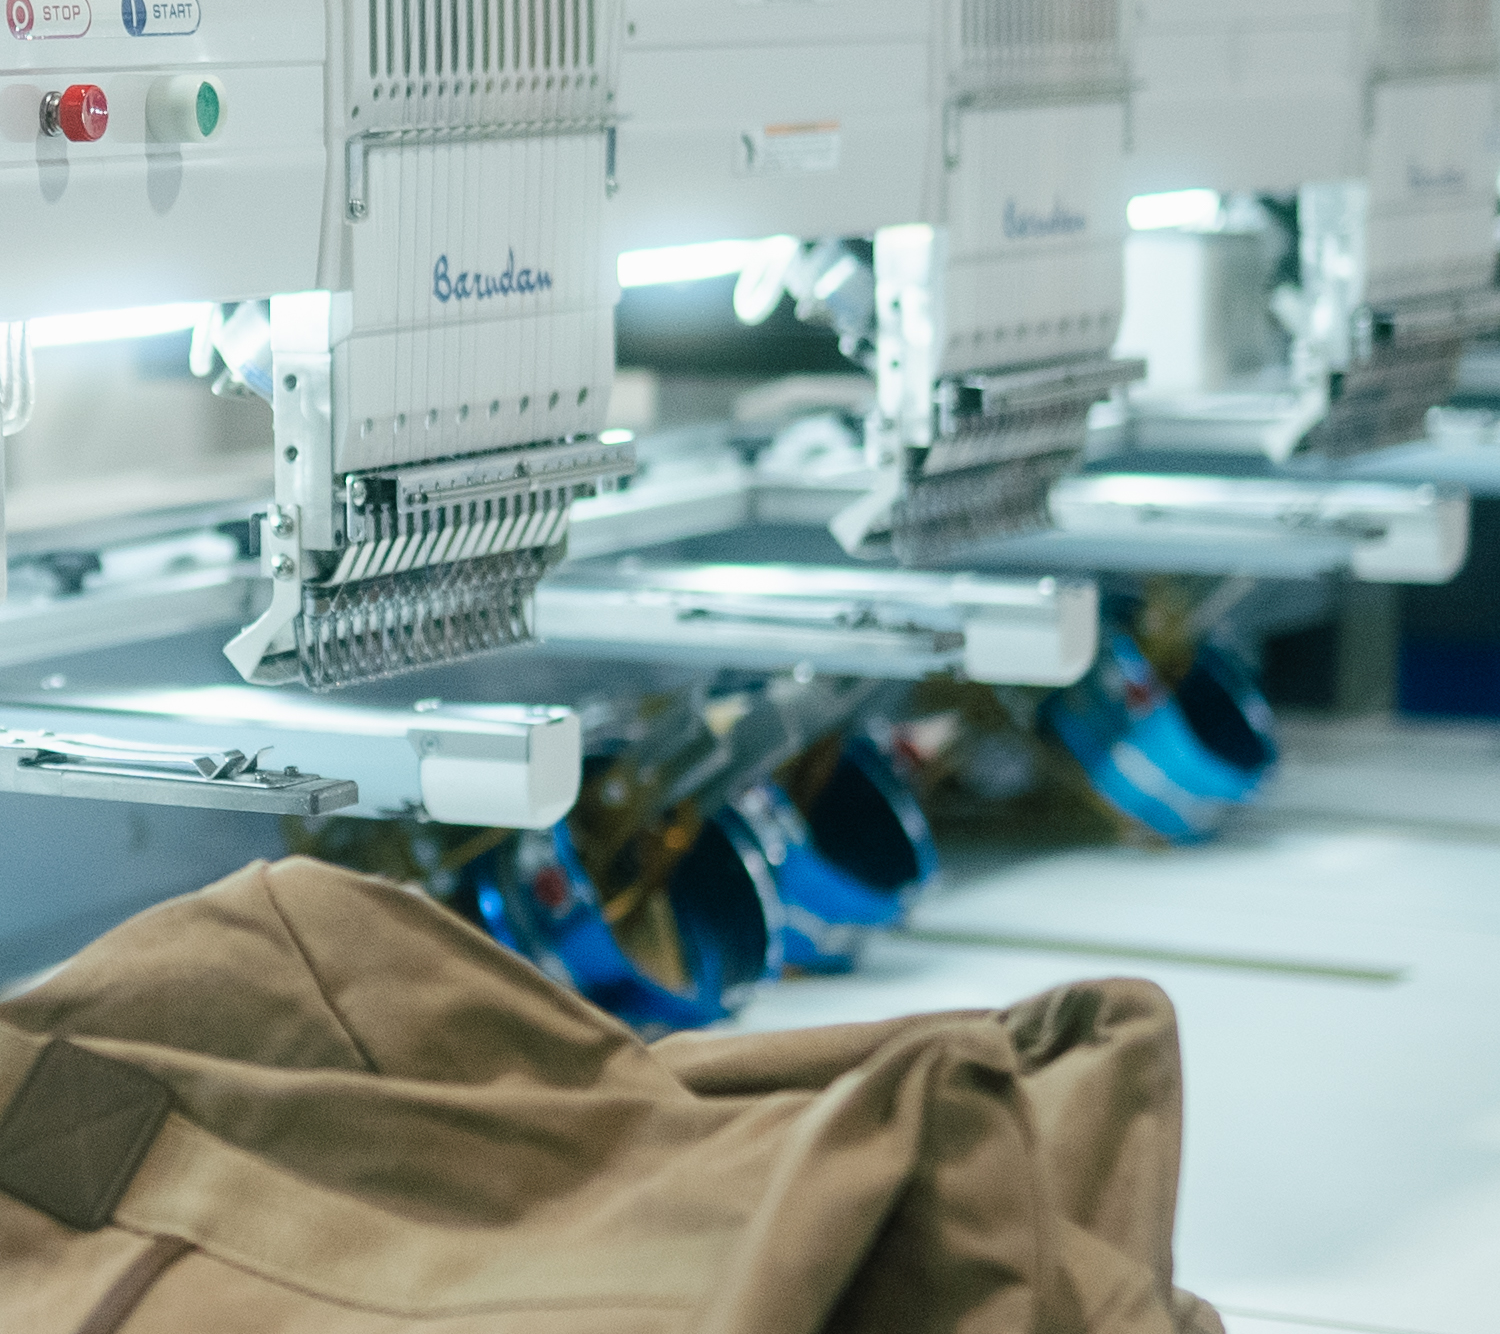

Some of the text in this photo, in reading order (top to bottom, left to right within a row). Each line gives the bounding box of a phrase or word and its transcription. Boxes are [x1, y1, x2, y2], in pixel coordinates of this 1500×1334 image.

[42, 5, 81, 21] STOP
[152, 3, 192, 19] START
[432, 245, 552, 303] Barudan
